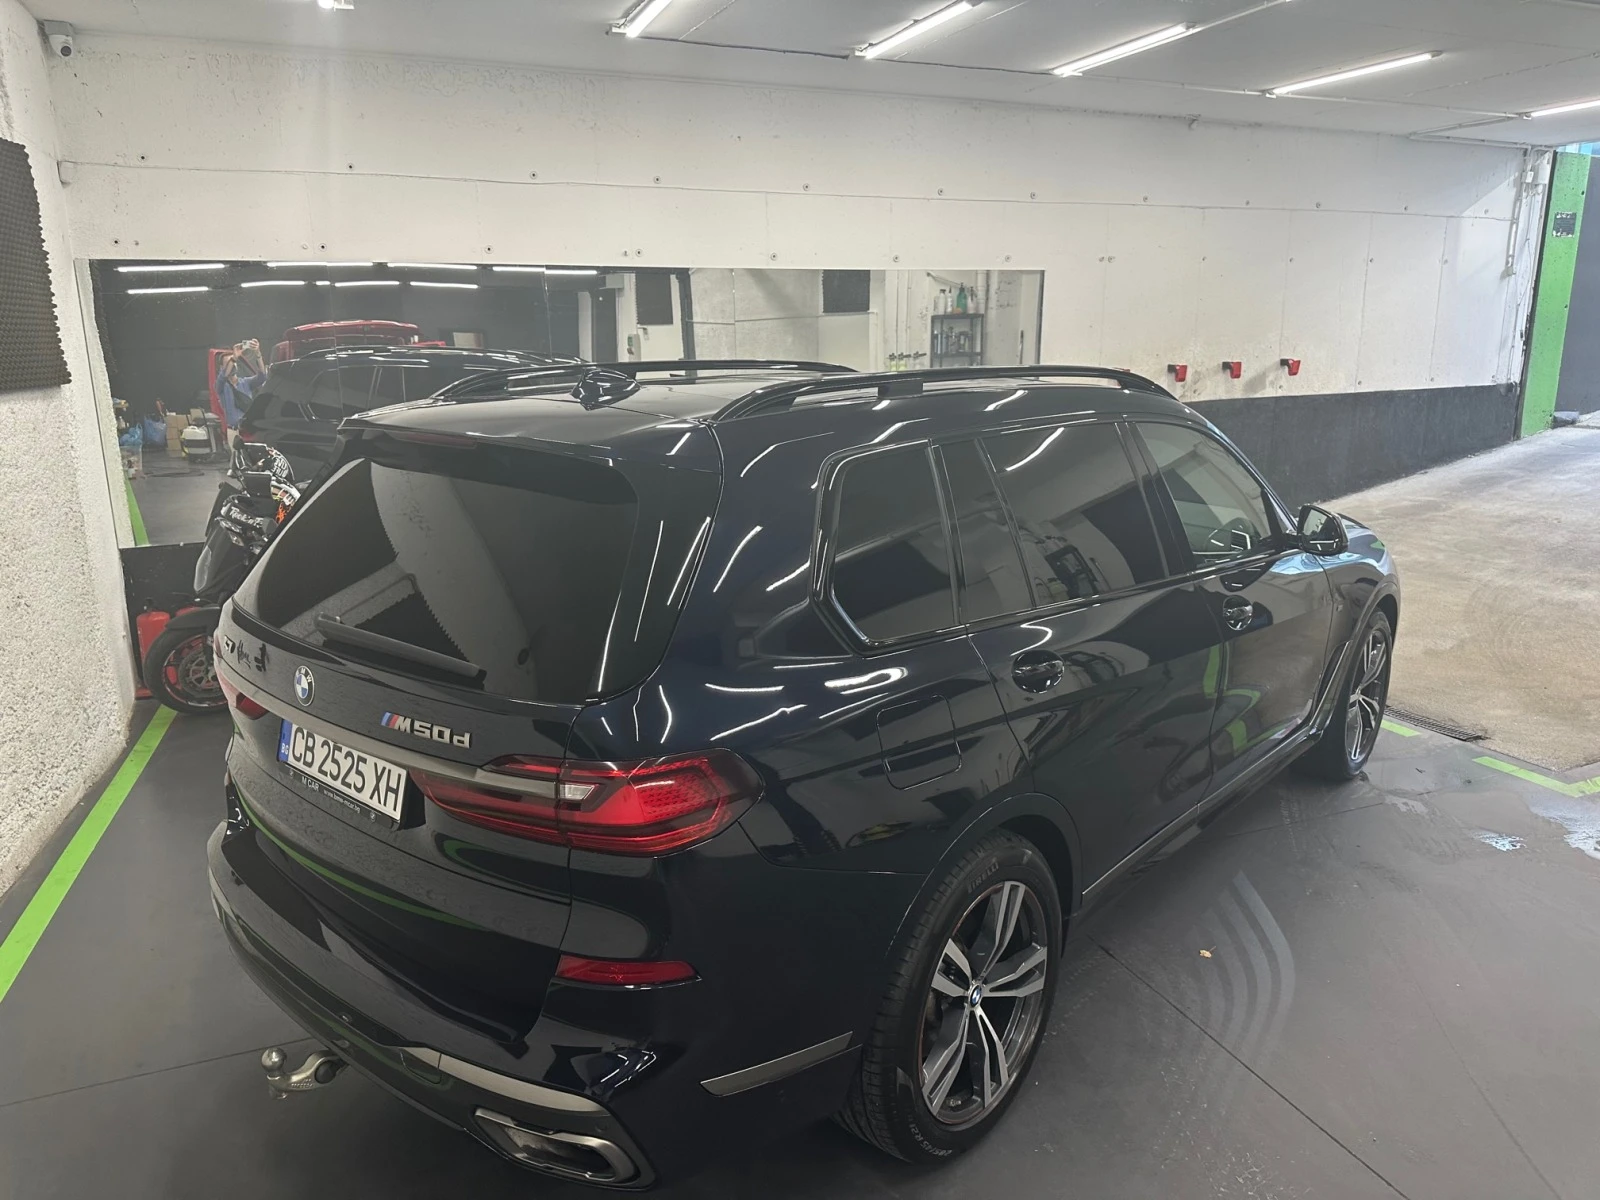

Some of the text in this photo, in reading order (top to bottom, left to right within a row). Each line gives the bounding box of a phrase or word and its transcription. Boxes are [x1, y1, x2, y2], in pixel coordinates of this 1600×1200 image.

[281, 742, 290, 755] BG
[393, 714, 470, 749] M50d
[292, 726, 402, 812] CB 2525 XH
